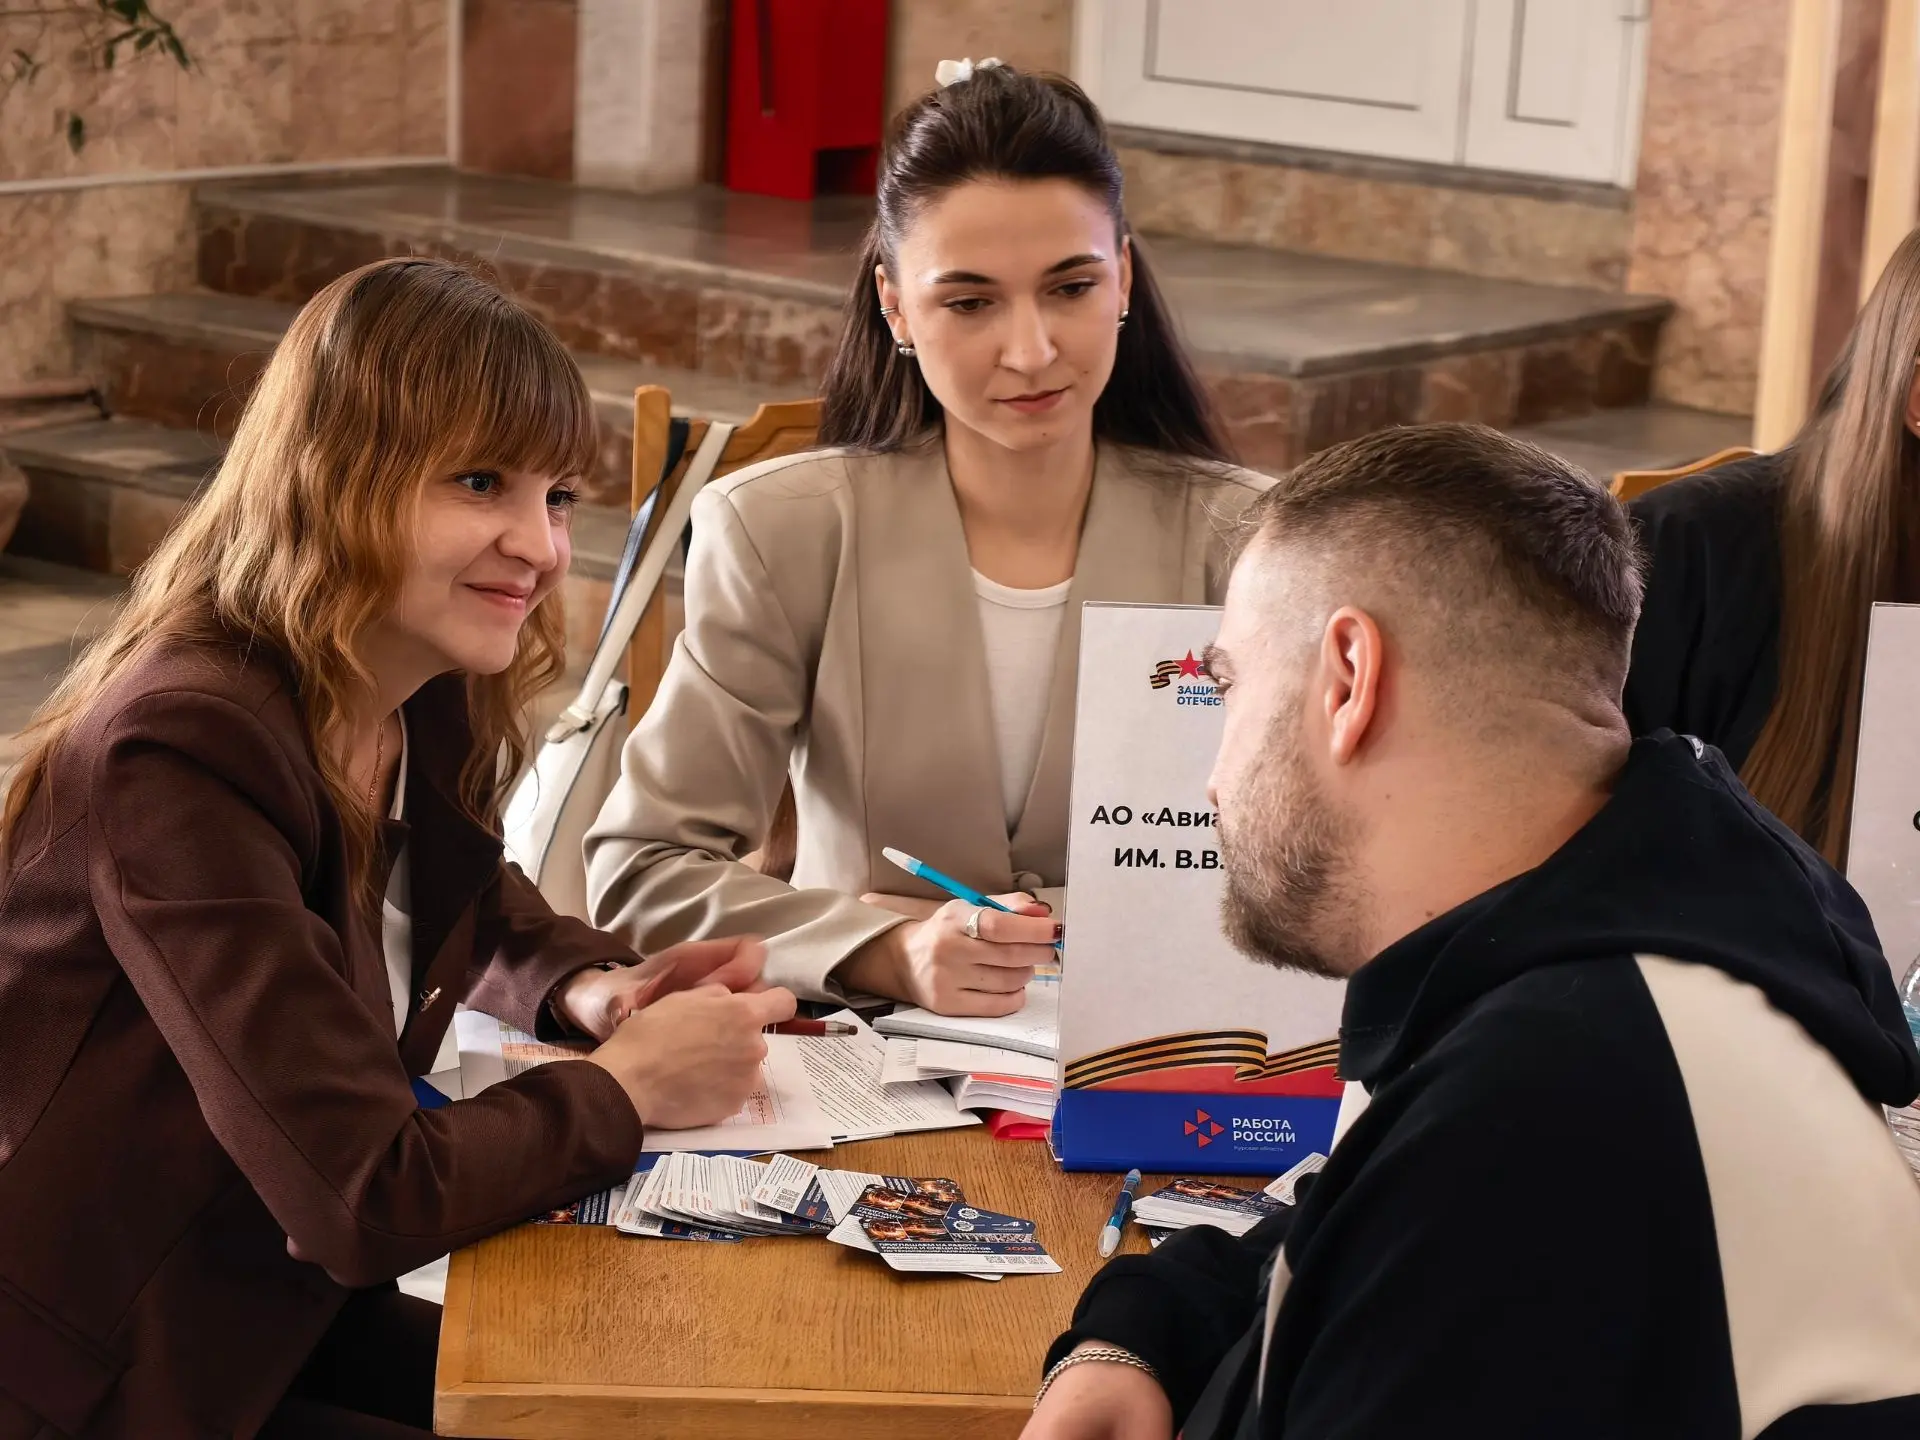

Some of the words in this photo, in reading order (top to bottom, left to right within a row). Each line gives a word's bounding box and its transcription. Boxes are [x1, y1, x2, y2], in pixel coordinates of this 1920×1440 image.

[1090, 805, 1133, 825] АО
[1114, 848, 1166, 868] ИМ.
[1232, 1117, 1292, 1130] РАБОТА
[1233, 1130, 1296, 1143] РОССИИ
